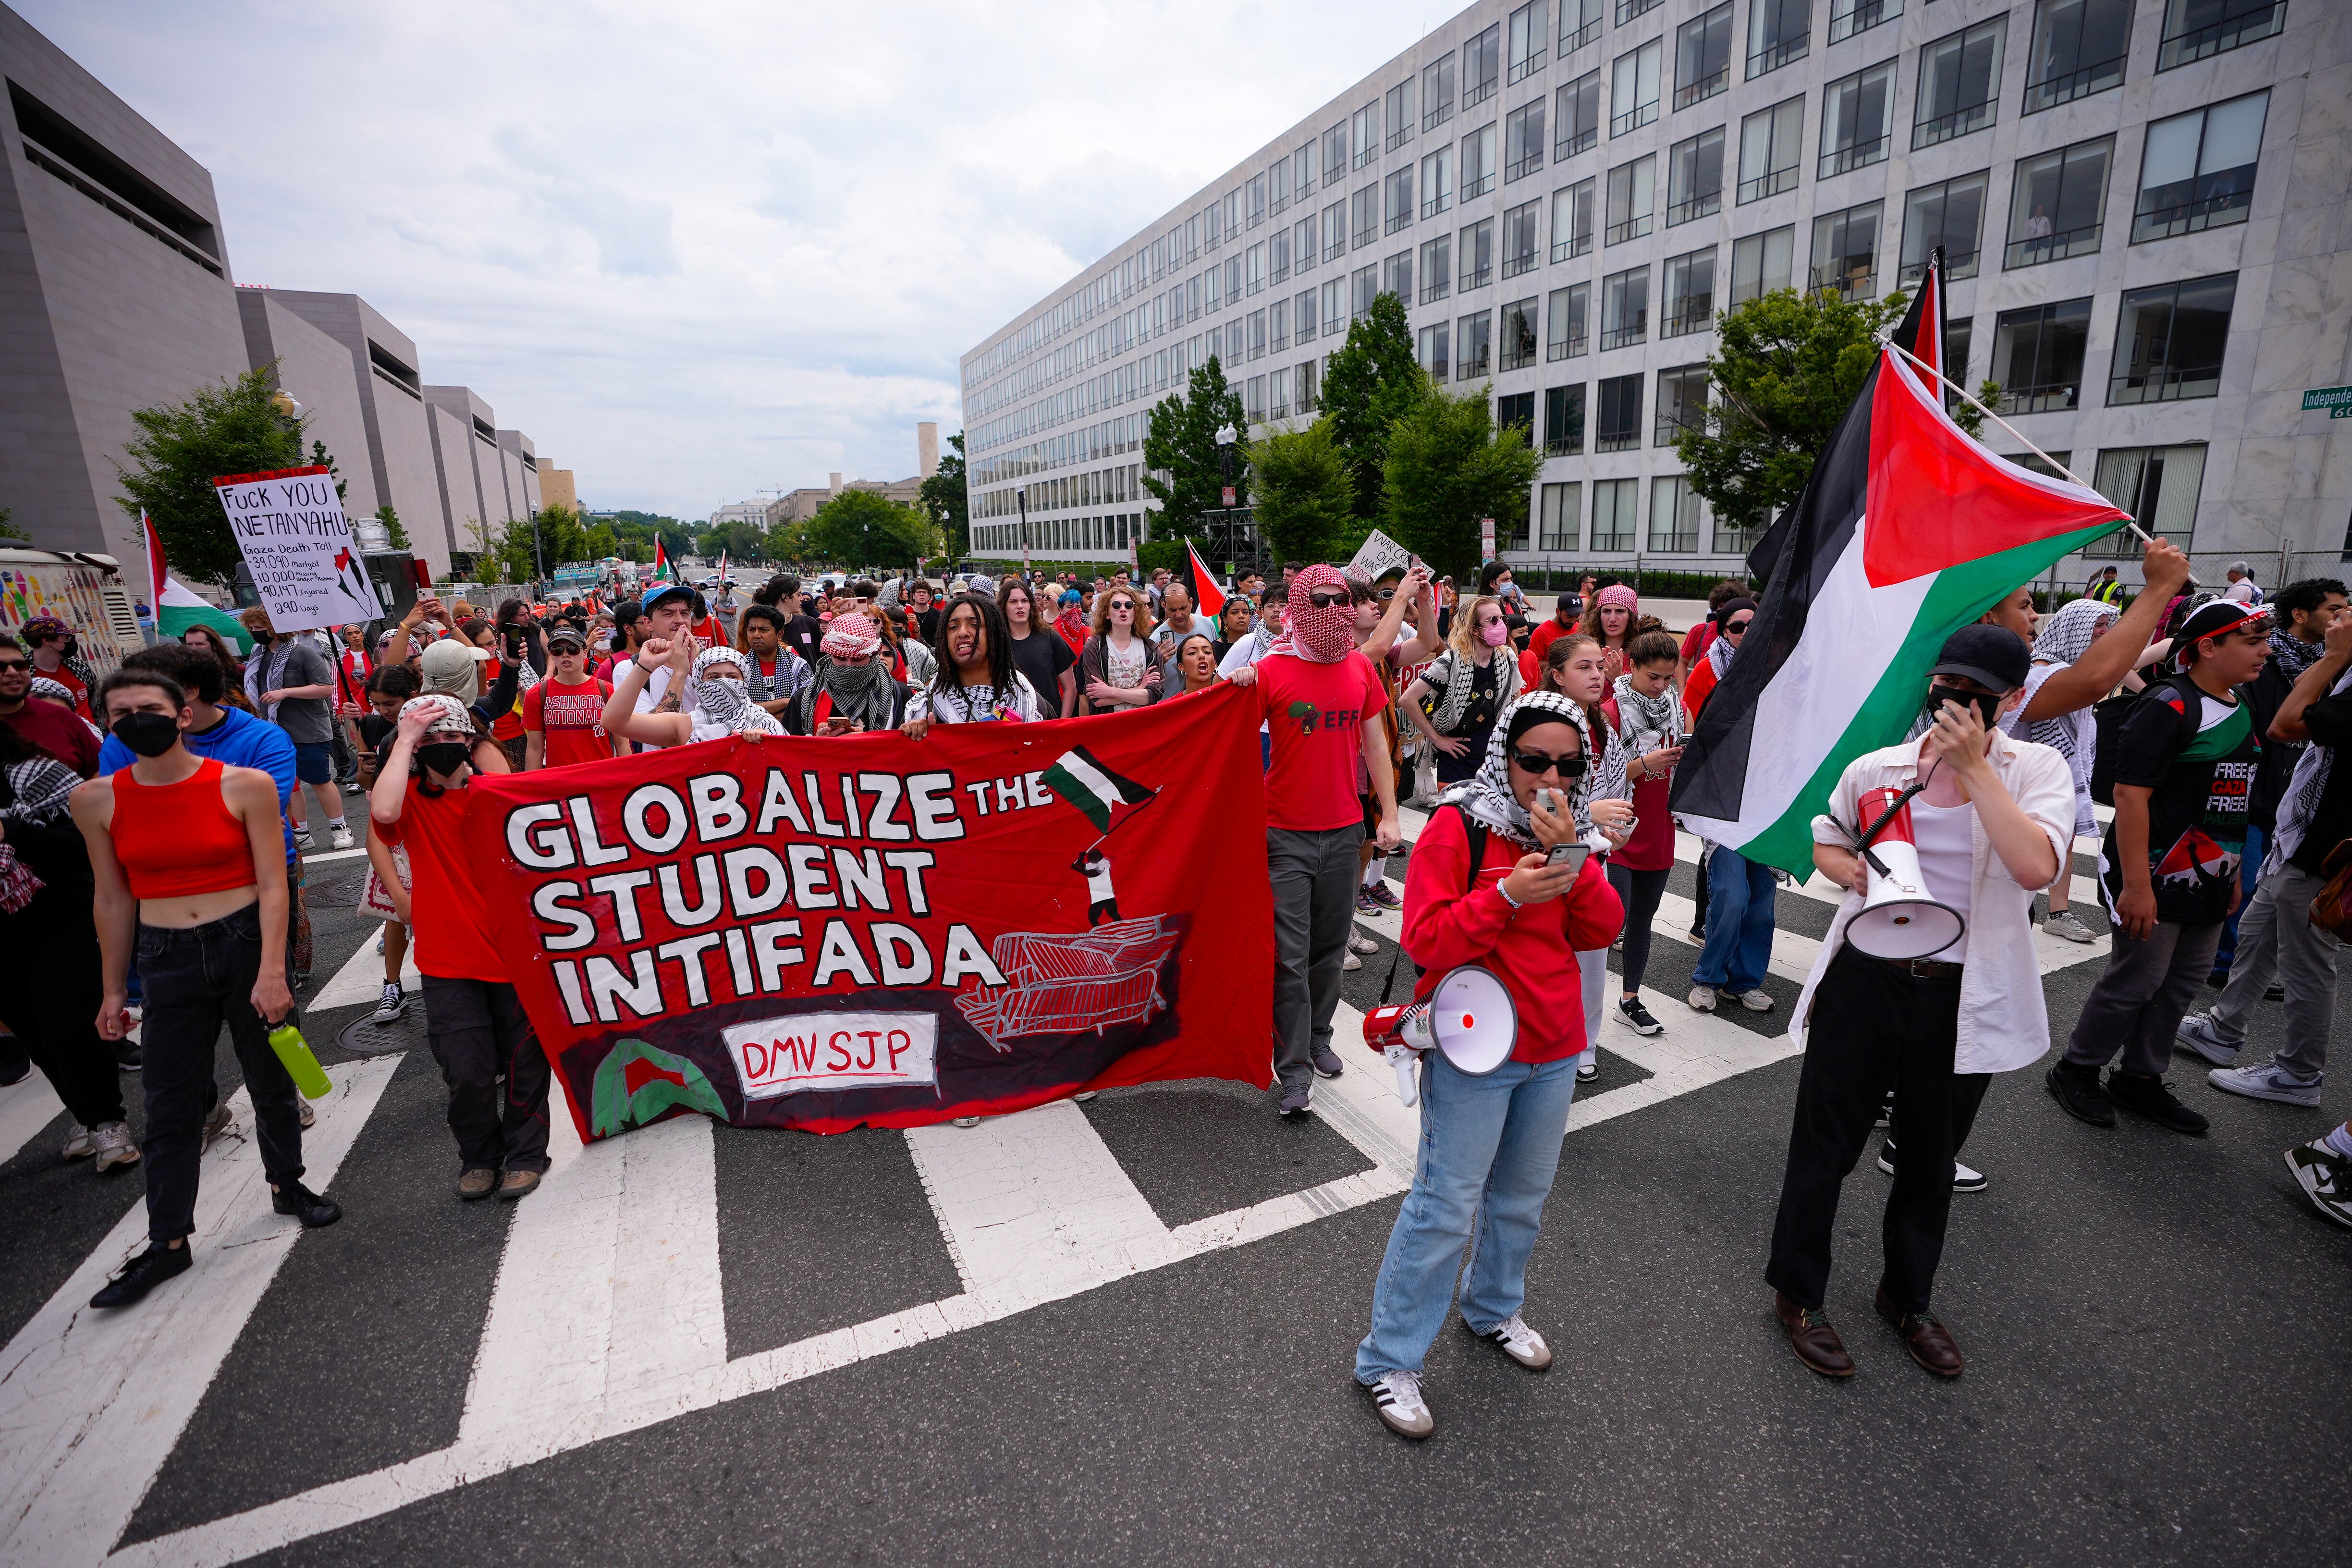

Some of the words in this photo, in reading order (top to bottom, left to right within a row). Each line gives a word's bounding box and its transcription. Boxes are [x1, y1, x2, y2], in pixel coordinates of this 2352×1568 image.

[2304, 388, 2352, 408] Independe
[250, 472, 269, 482] The
[280, 482, 328, 507] YOU
[234, 511, 349, 537] NETANYAHU
[244, 544, 275, 554] Gaza
[278, 542, 310, 553] Death
[312, 541, 332, 551] Toll
[1374, 533, 1396, 552] WAR
[1377, 551, 1396, 568] OUT
[300, 588, 329, 598] Injured
[274, 600, 298, 614] 290
[299, 604, 319, 615] Days
[544, 695, 605, 709] ASHINGTO
[544, 710, 603, 724] ATIONAL
[1325, 710, 1360, 728] EFF
[2214, 763, 2247, 778] FREE
[2212, 781, 2246, 795] GAZA
[2206, 796, 2245, 812] FREE
[505, 767, 967, 871] GLOBALIZE
[967, 769, 1054, 816] THE
[530, 842, 936, 953] STUDENT
[551, 917, 1010, 1027] INTIFADA
[742, 1031, 817, 1079] DMV
[827, 1029, 911, 1072] SJP
